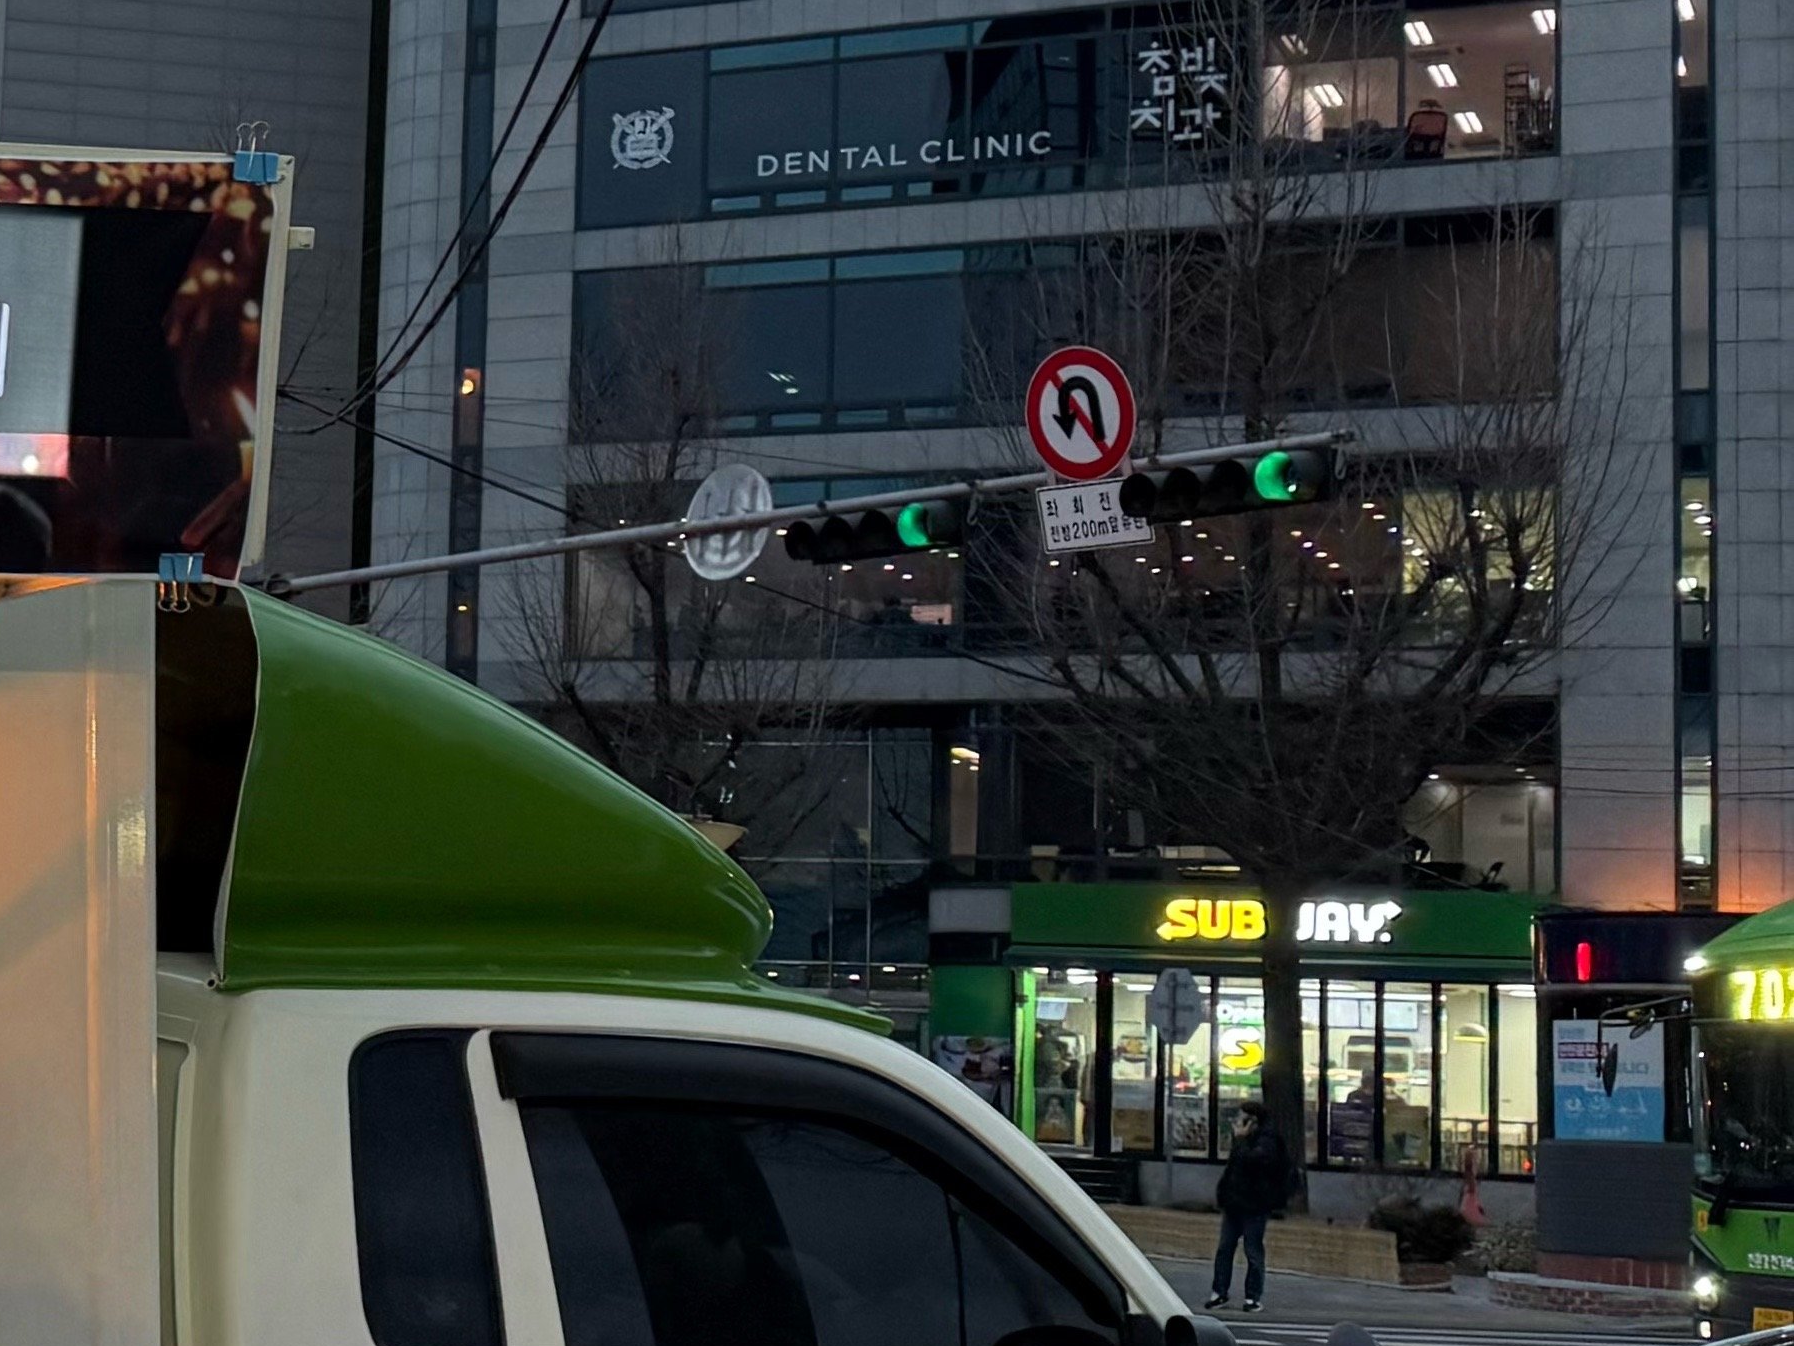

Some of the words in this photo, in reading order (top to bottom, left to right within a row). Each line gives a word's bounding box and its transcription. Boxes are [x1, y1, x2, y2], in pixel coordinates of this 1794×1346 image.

[1138, 37, 1229, 97] 참빛
[1130, 98, 1222, 142] 치과
[757, 143, 908, 178] DENTAL
[919, 130, 1053, 166] CLINIC
[1727, 967, 1794, 1022] 70
